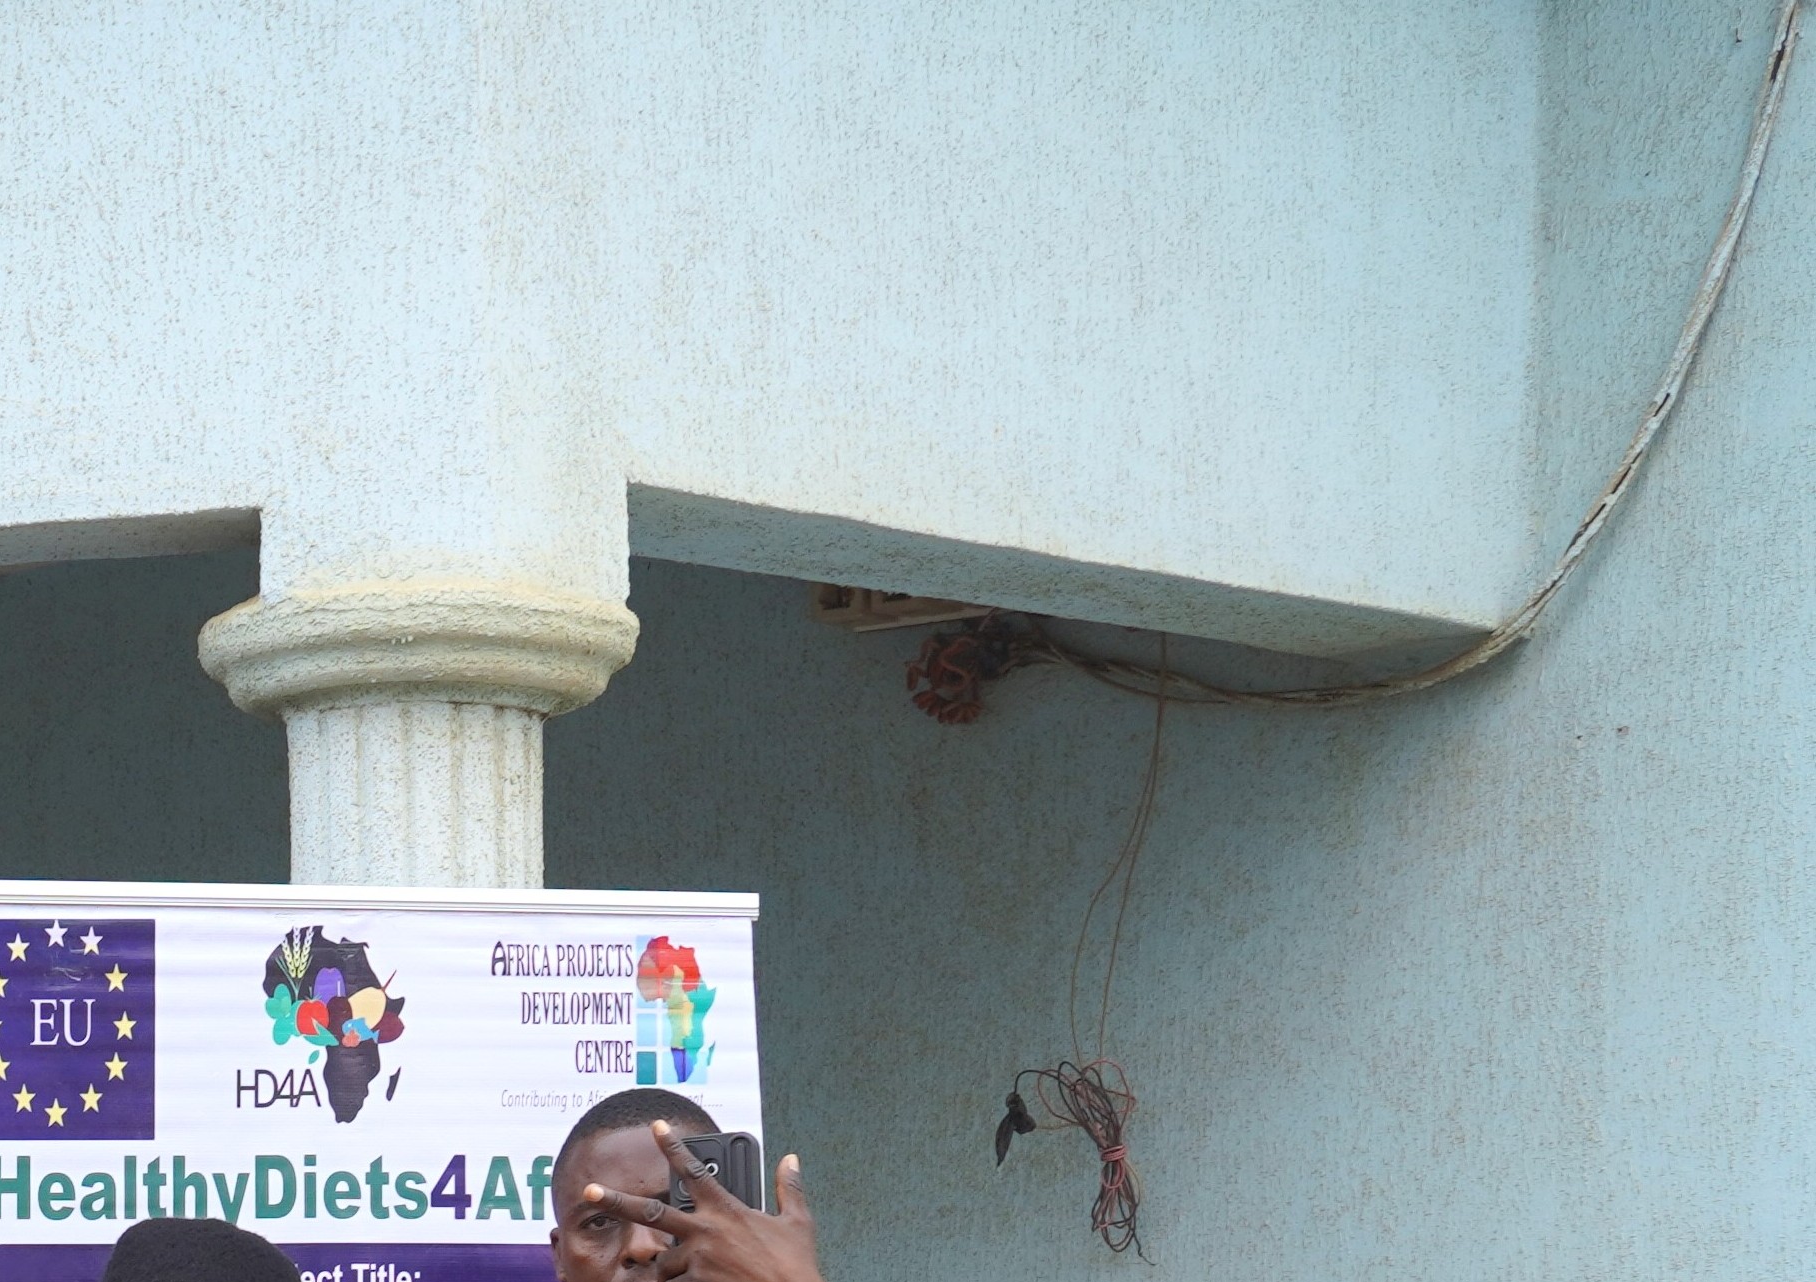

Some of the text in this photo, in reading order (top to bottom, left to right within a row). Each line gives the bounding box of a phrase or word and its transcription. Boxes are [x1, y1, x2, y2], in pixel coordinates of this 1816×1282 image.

[491, 941, 634, 977] AFRICA PROJECTS
[30, 999, 96, 1046] EU
[521, 992, 634, 1025] DEVELOPMENT
[575, 1040, 634, 1073] CENTRE
[237, 1069, 321, 1108] HD4A
[501, 1090, 567, 1112] Contributing
[572, 1091, 583, 1108] to
